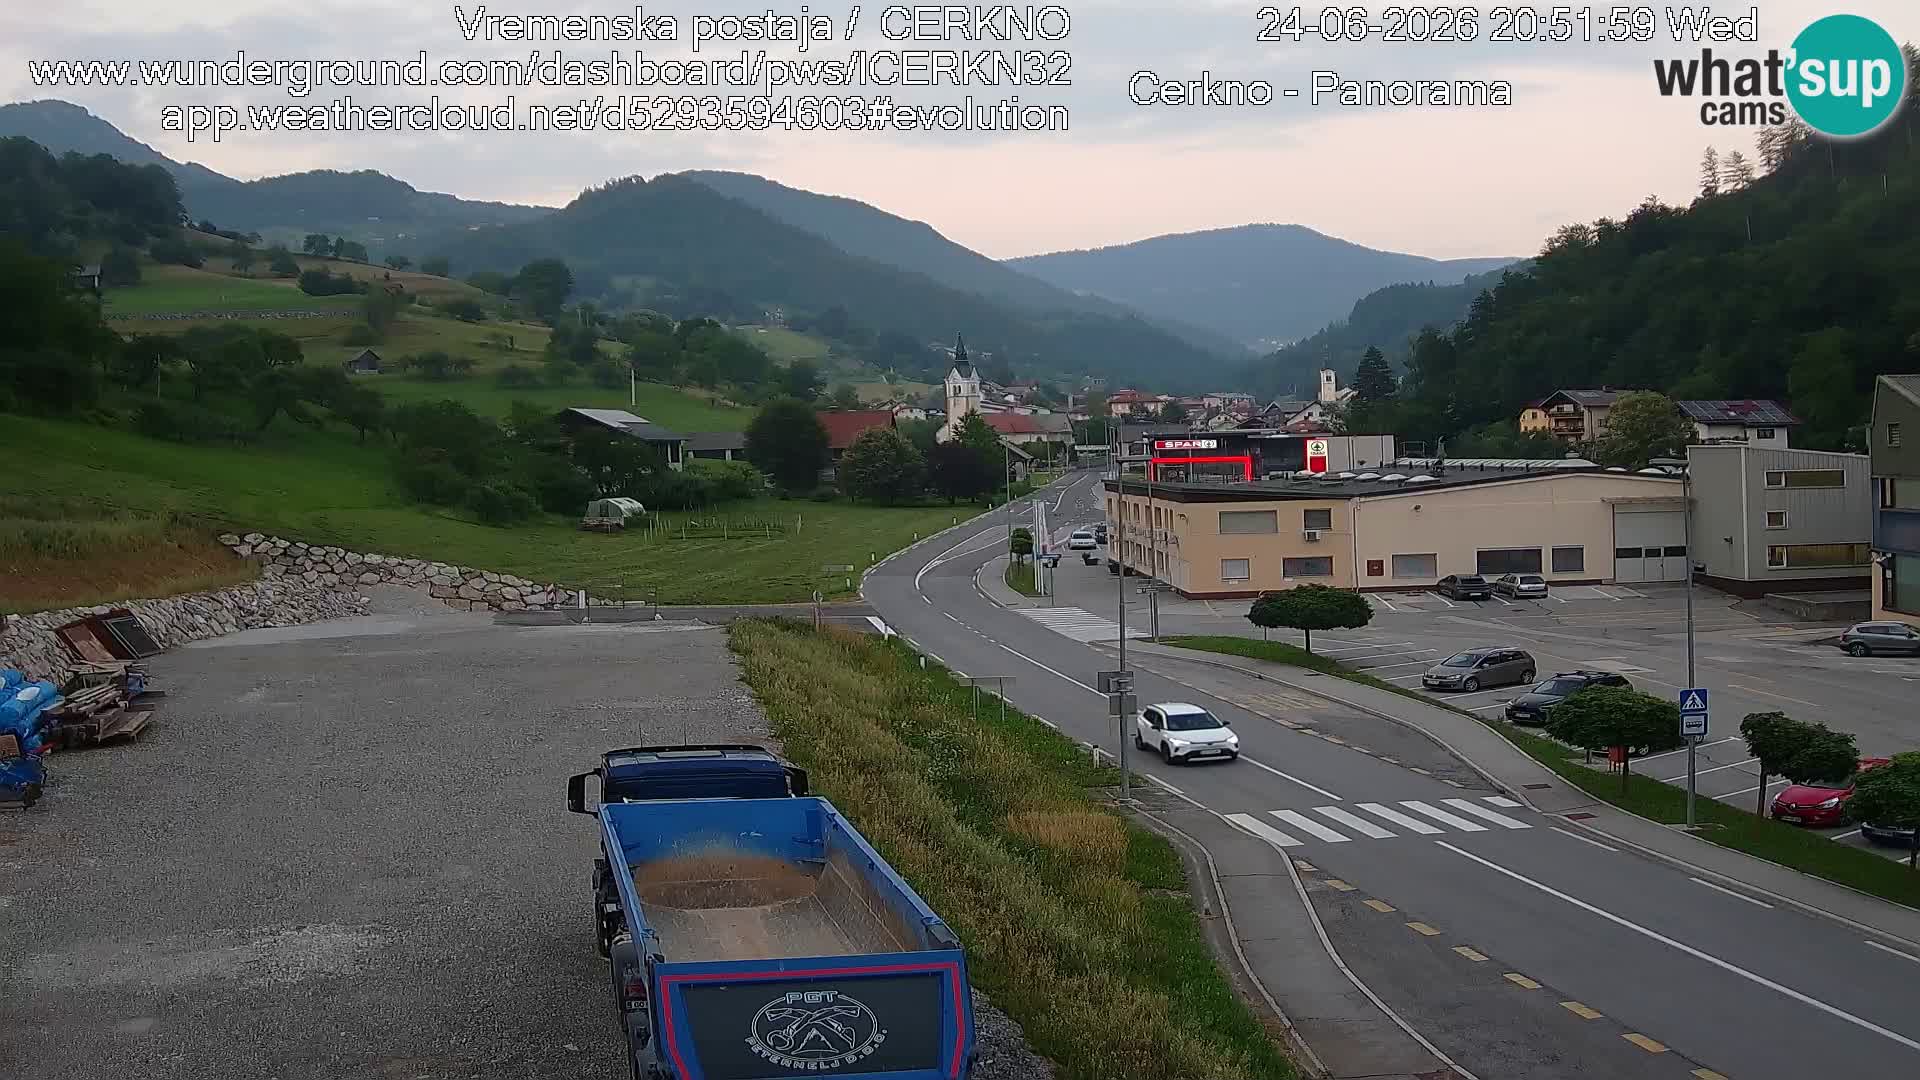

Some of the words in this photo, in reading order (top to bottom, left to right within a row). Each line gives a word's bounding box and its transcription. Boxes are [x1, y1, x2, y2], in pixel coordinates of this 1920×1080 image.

[1165, 441, 1201, 449] SPAR
[785, 990, 839, 1005] PGT
[744, 1036, 840, 1070] PETERNELJ
